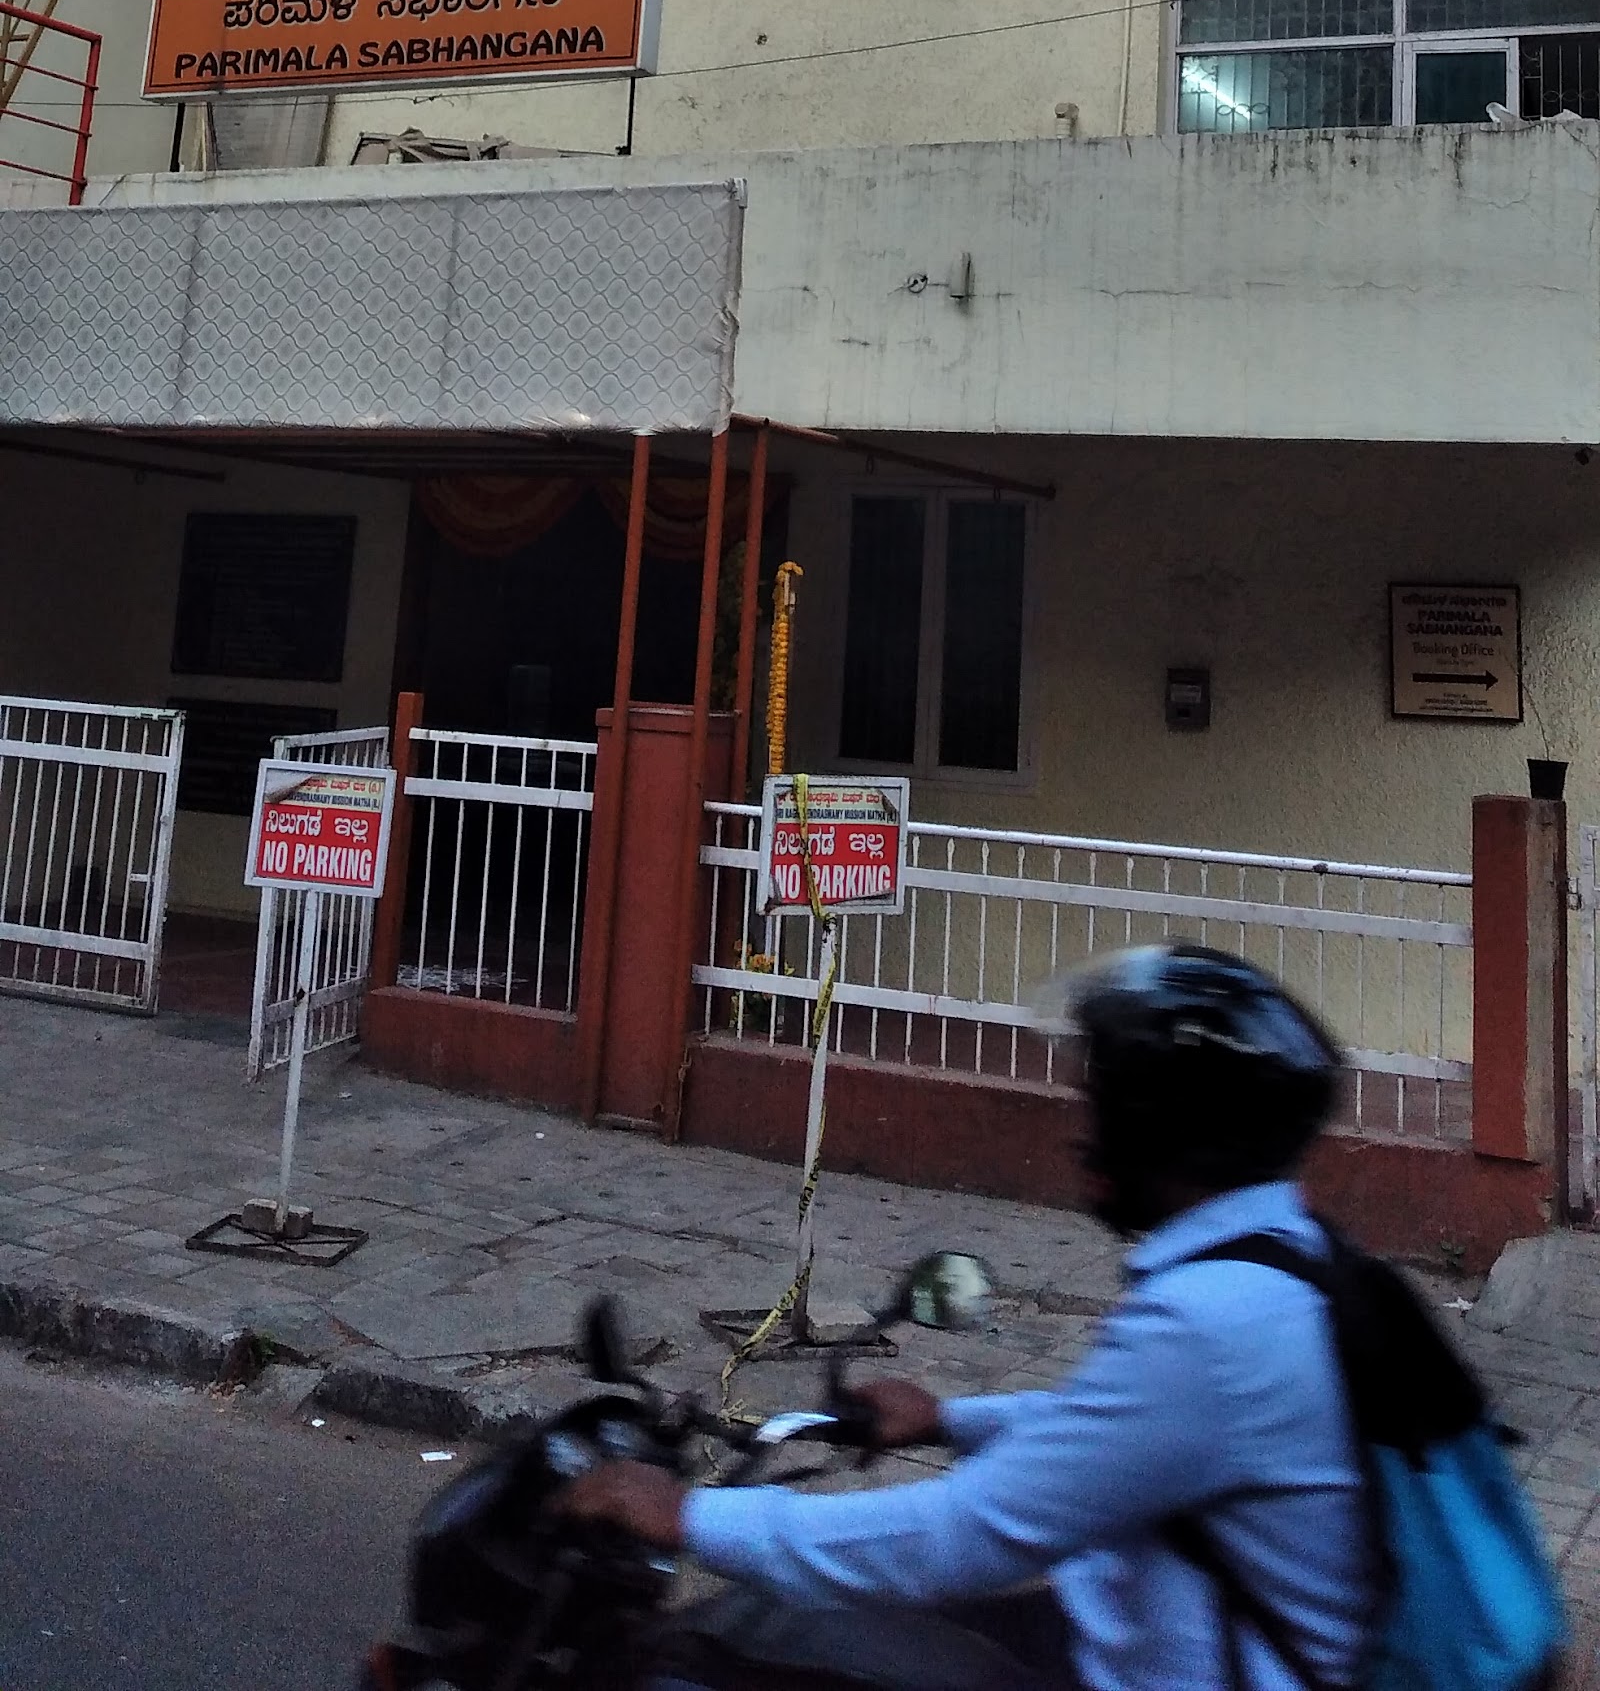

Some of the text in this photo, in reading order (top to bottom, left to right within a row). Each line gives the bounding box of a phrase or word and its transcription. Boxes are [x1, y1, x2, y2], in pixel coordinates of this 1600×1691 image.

[175, 26, 604, 79] PARIMALA SABHANGANA
[1407, 623, 1503, 637] SABHANGANA
[1418, 610, 1491, 623] PARIMALA
[1412, 642, 1494, 657] Booking Office
[265, 809, 369, 843] ನಿಲುಗಡೆ ಇಲ್ಲ
[262, 840, 372, 881] NO PARKING
[848, 832, 885, 859] ಇಲ್ಲ
[775, 864, 800, 899] NO
